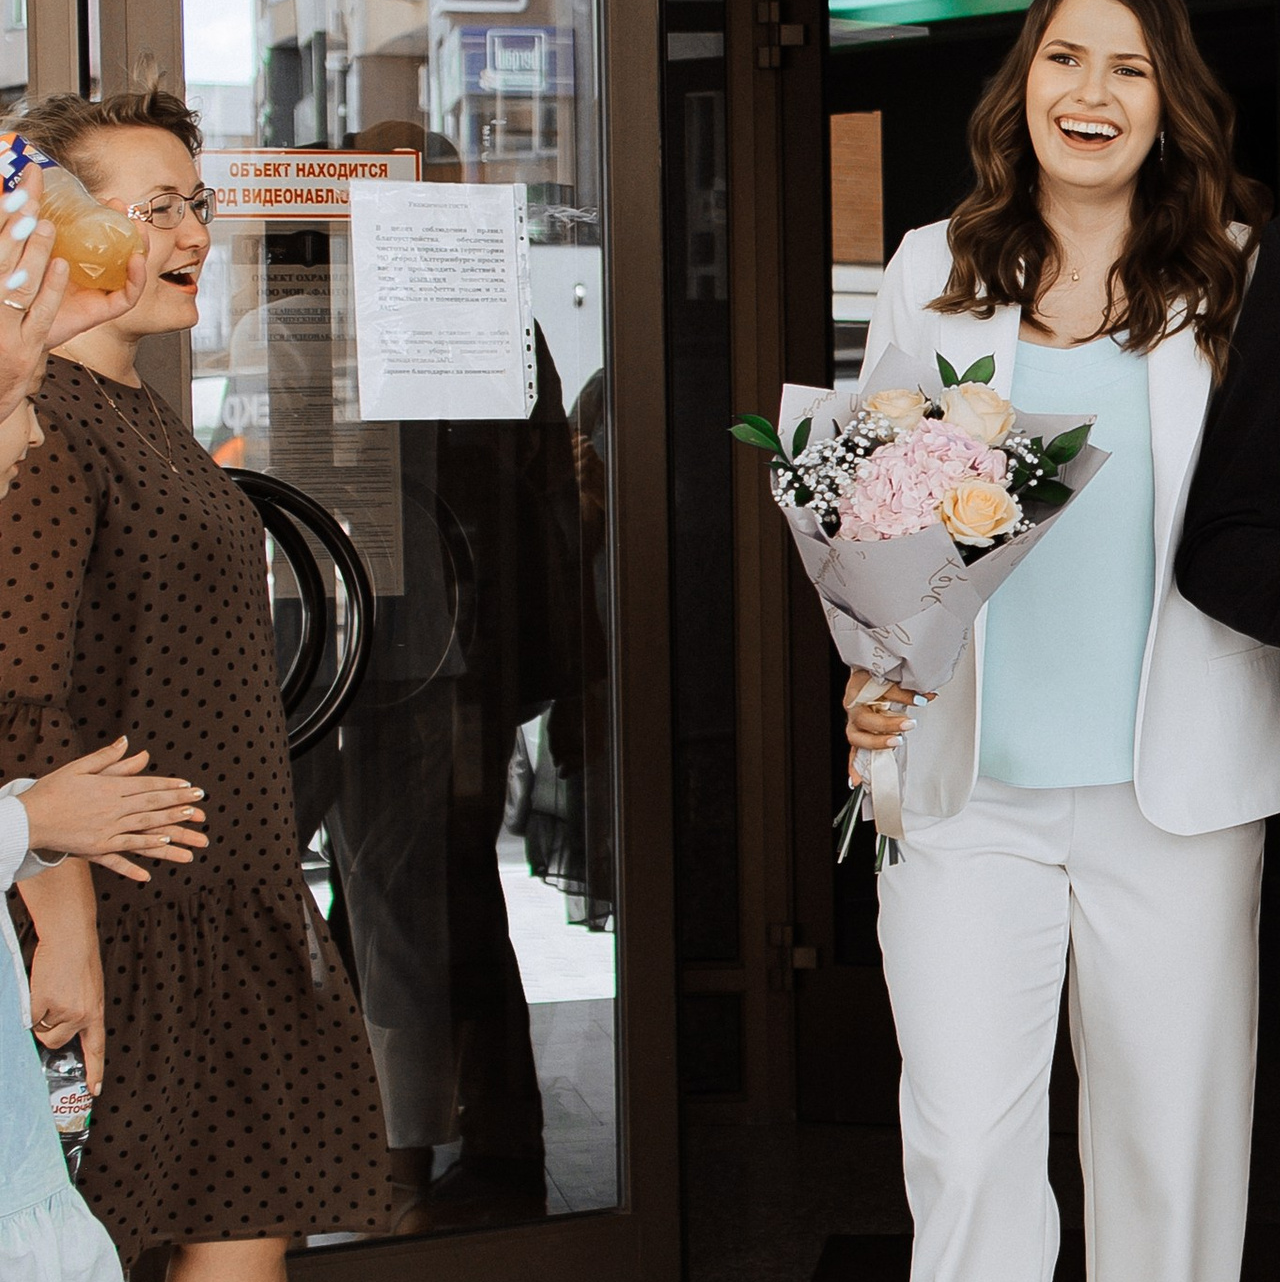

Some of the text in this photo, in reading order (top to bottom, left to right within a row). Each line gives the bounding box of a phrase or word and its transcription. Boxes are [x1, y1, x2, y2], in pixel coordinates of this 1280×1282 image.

[229, 162, 389, 181] ОБЪЕКТ НАХОДИТСЯ
[217, 188, 238, 206] ОД
